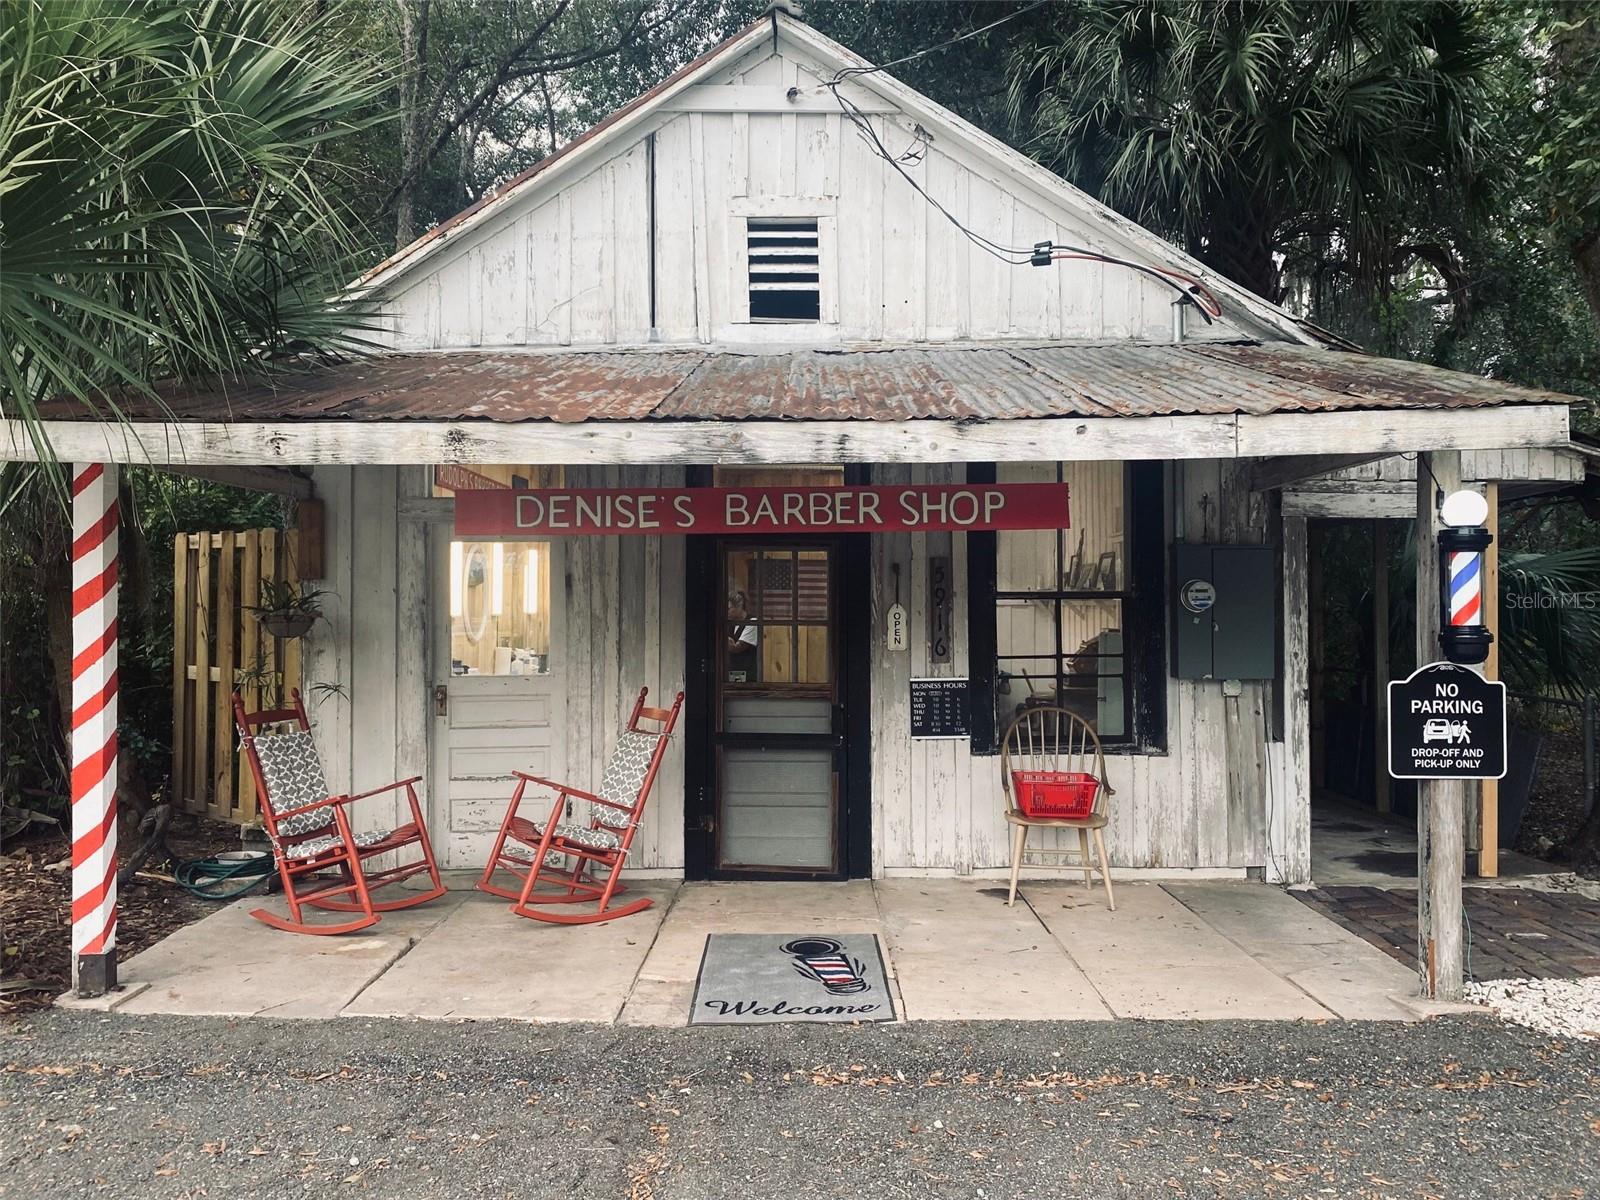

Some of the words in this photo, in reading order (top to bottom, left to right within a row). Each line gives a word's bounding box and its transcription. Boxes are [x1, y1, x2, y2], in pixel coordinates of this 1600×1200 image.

[516, 495, 695, 529] DENISE'S
[725, 491, 883, 526] BARBER
[899, 490, 1005, 525] SHOP
[935, 566, 946, 656] 5916
[893, 612, 901, 645] OPEN
[1435, 683, 1459, 697] NO
[1411, 700, 1484, 714] PARKING
[1411, 748, 1460, 757] DROP-OFF
[1462, 748, 1484, 757] AND
[1414, 759, 1453, 768] PICK-UP
[1455, 759, 1481, 768] ONLY
[704, 1000, 881, 1016] Welcome
